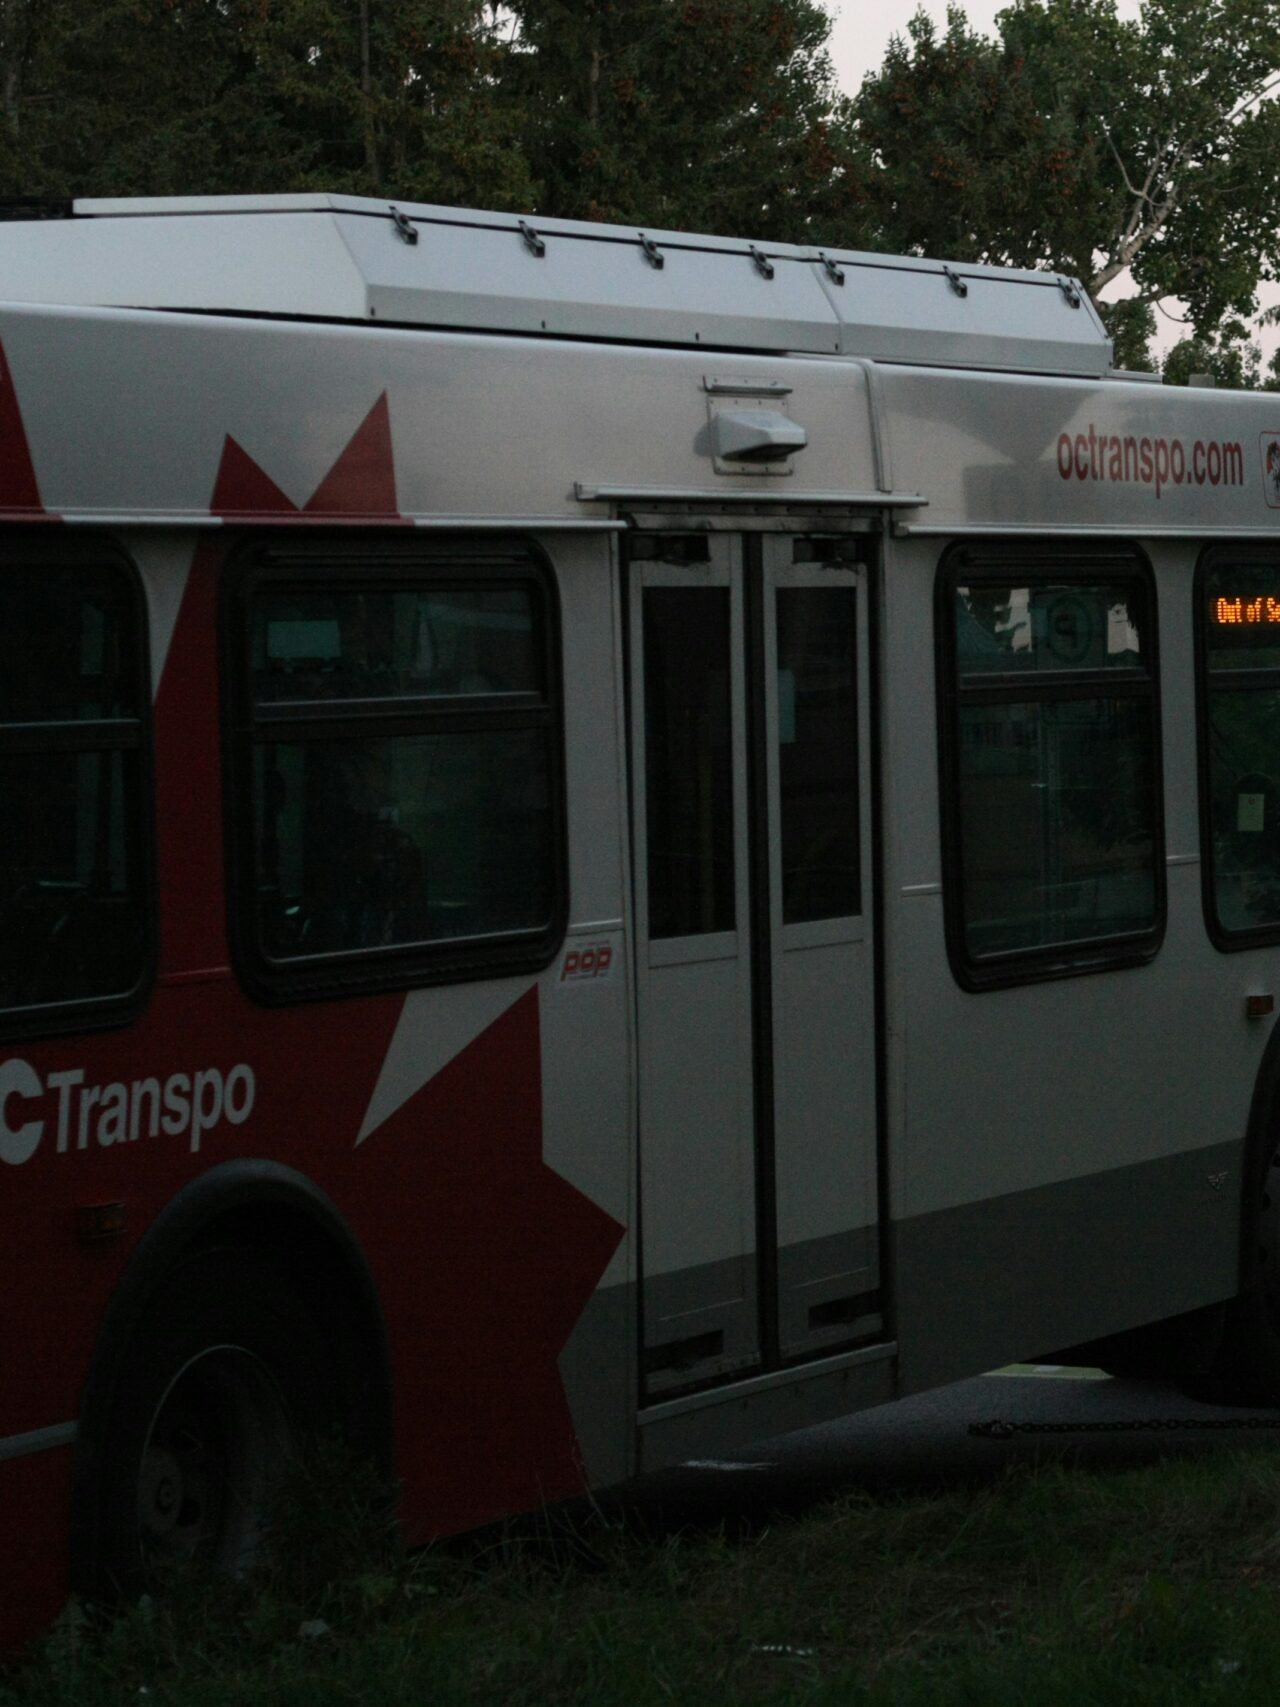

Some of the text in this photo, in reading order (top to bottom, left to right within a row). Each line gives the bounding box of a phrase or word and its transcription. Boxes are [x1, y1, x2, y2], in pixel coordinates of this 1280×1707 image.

[1057, 423, 1244, 500] octranspo.com
[1216, 597, 1242, 623] Out
[1246, 597, 1262, 622] of
[560, 946, 612, 982] pop
[47, 1063, 256, 1153] Transpo
